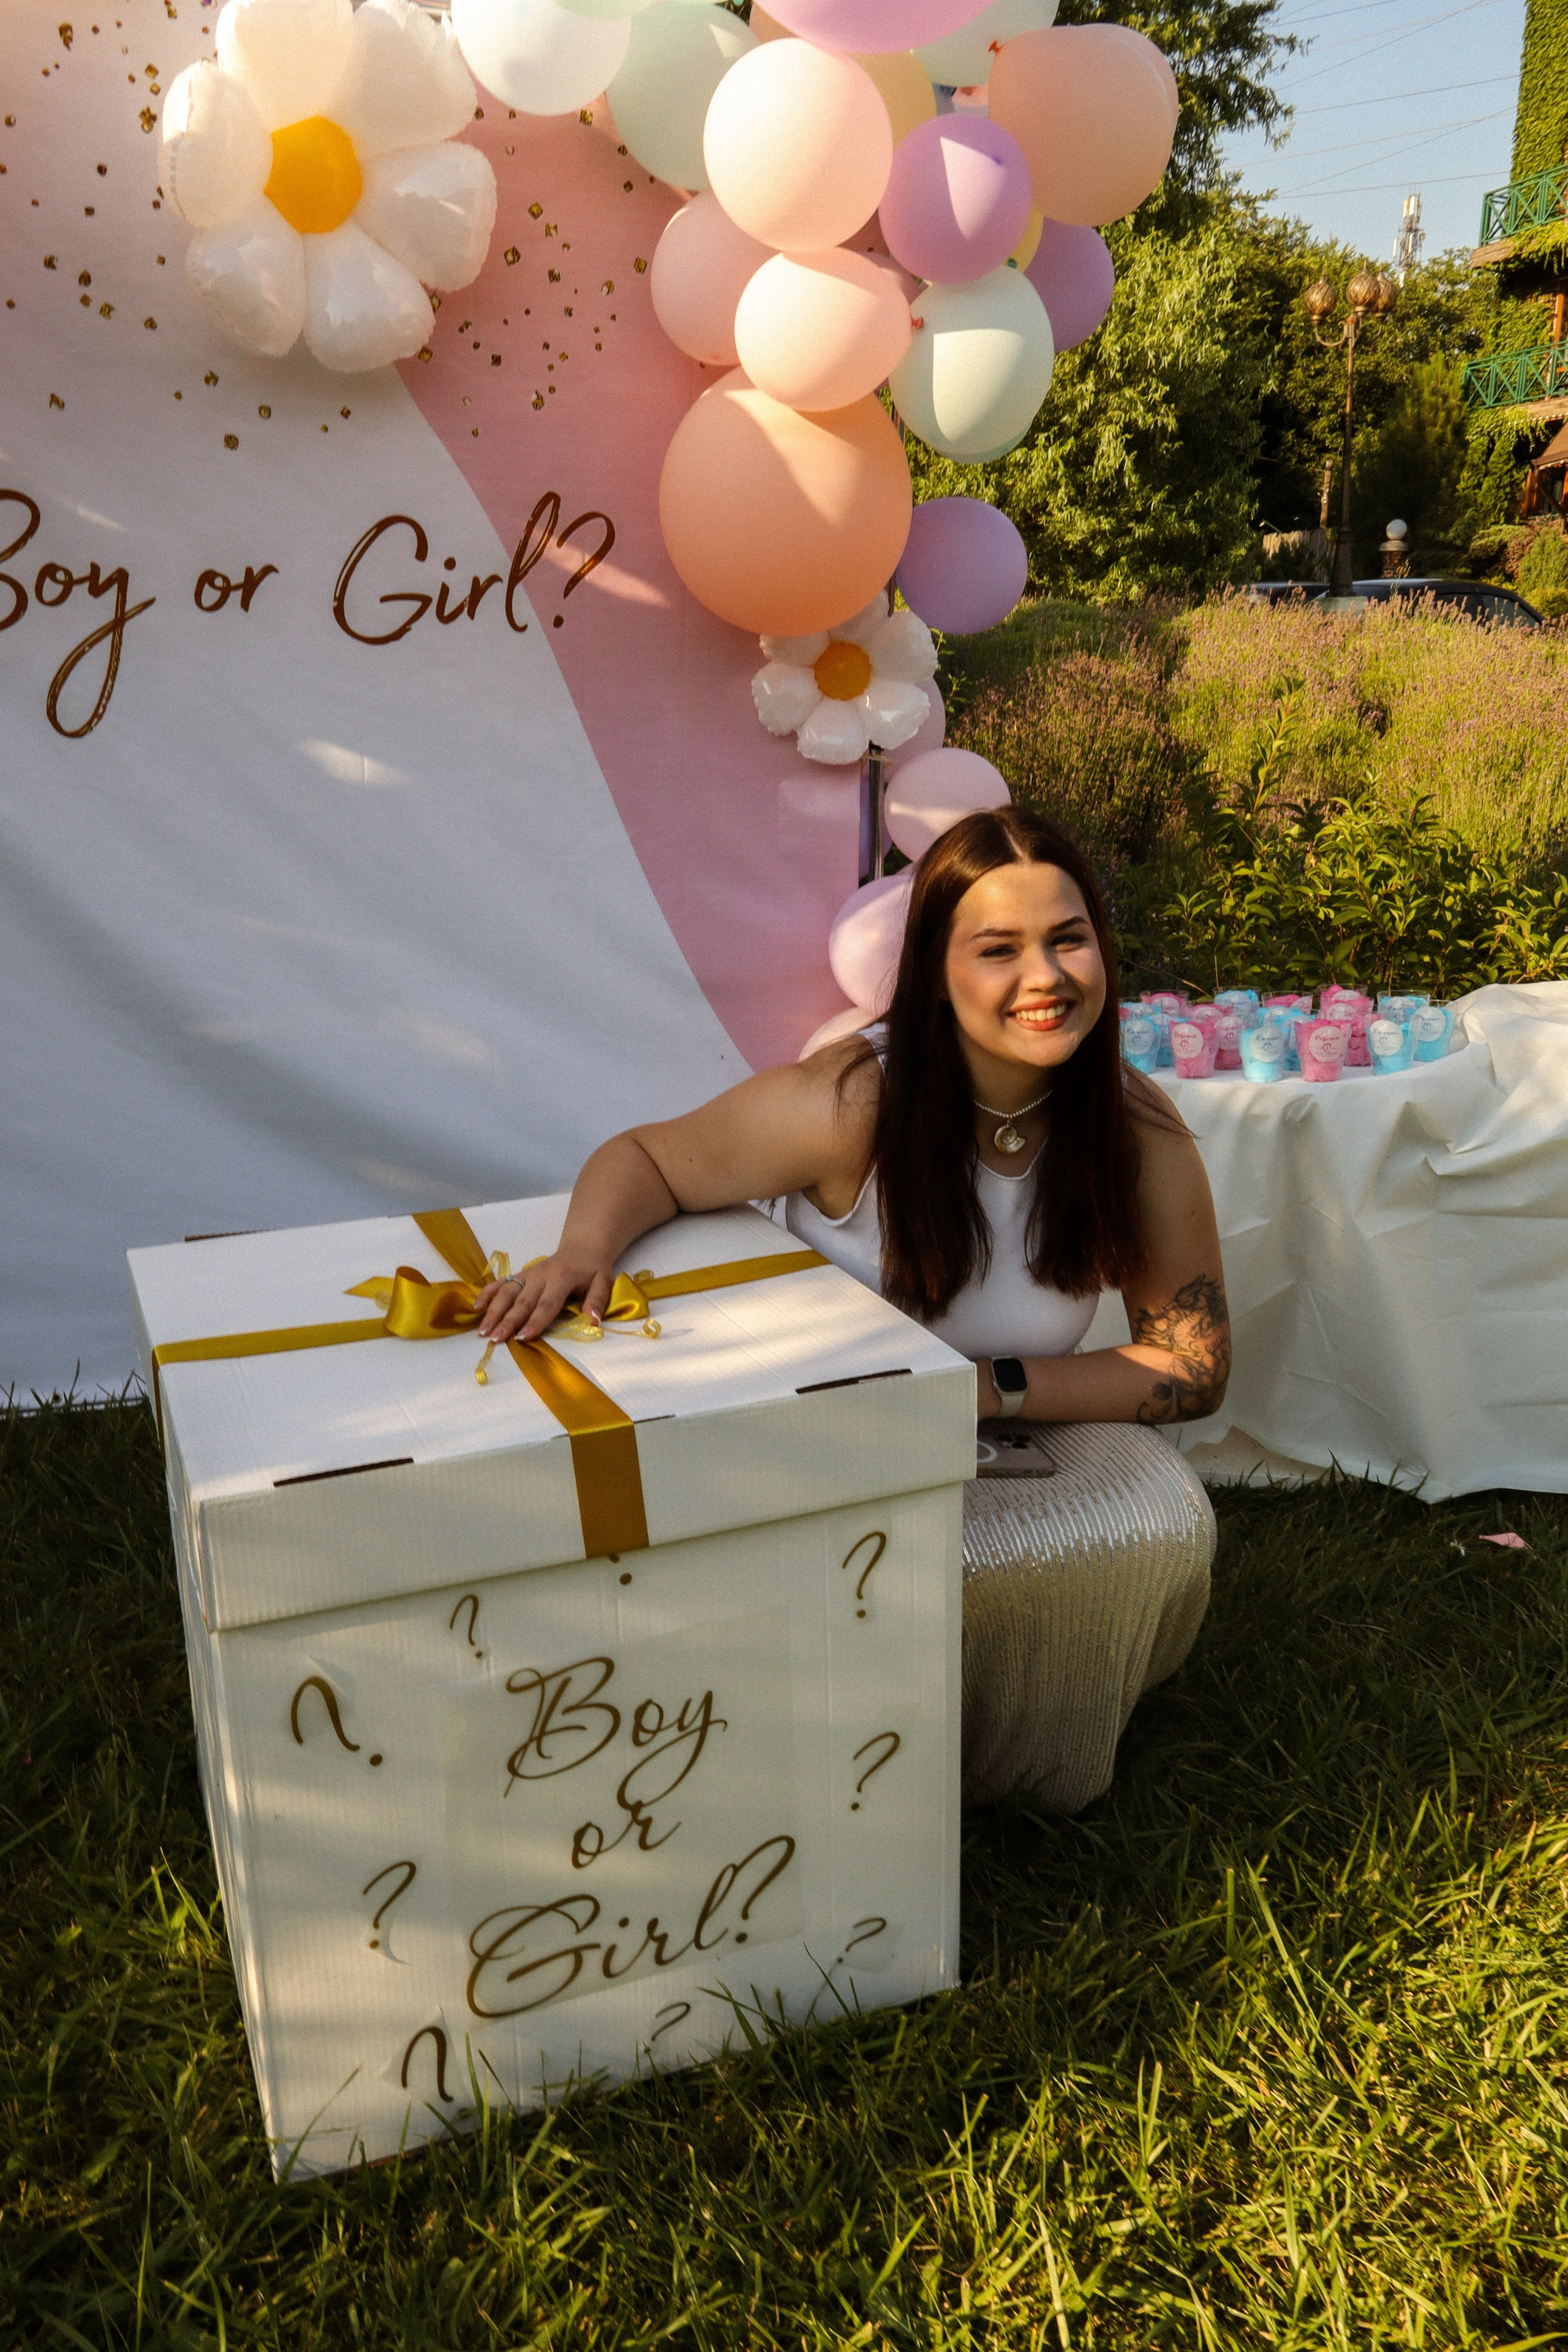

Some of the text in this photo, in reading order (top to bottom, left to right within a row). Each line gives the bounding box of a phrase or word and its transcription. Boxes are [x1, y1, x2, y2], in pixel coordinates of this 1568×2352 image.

[194, 564, 279, 612] or
[333, 490, 616, 646] Girl?
[504, 1656, 728, 1811] Boy
[571, 1799, 682, 1869] or
[466, 1834, 796, 2019] Girl?
